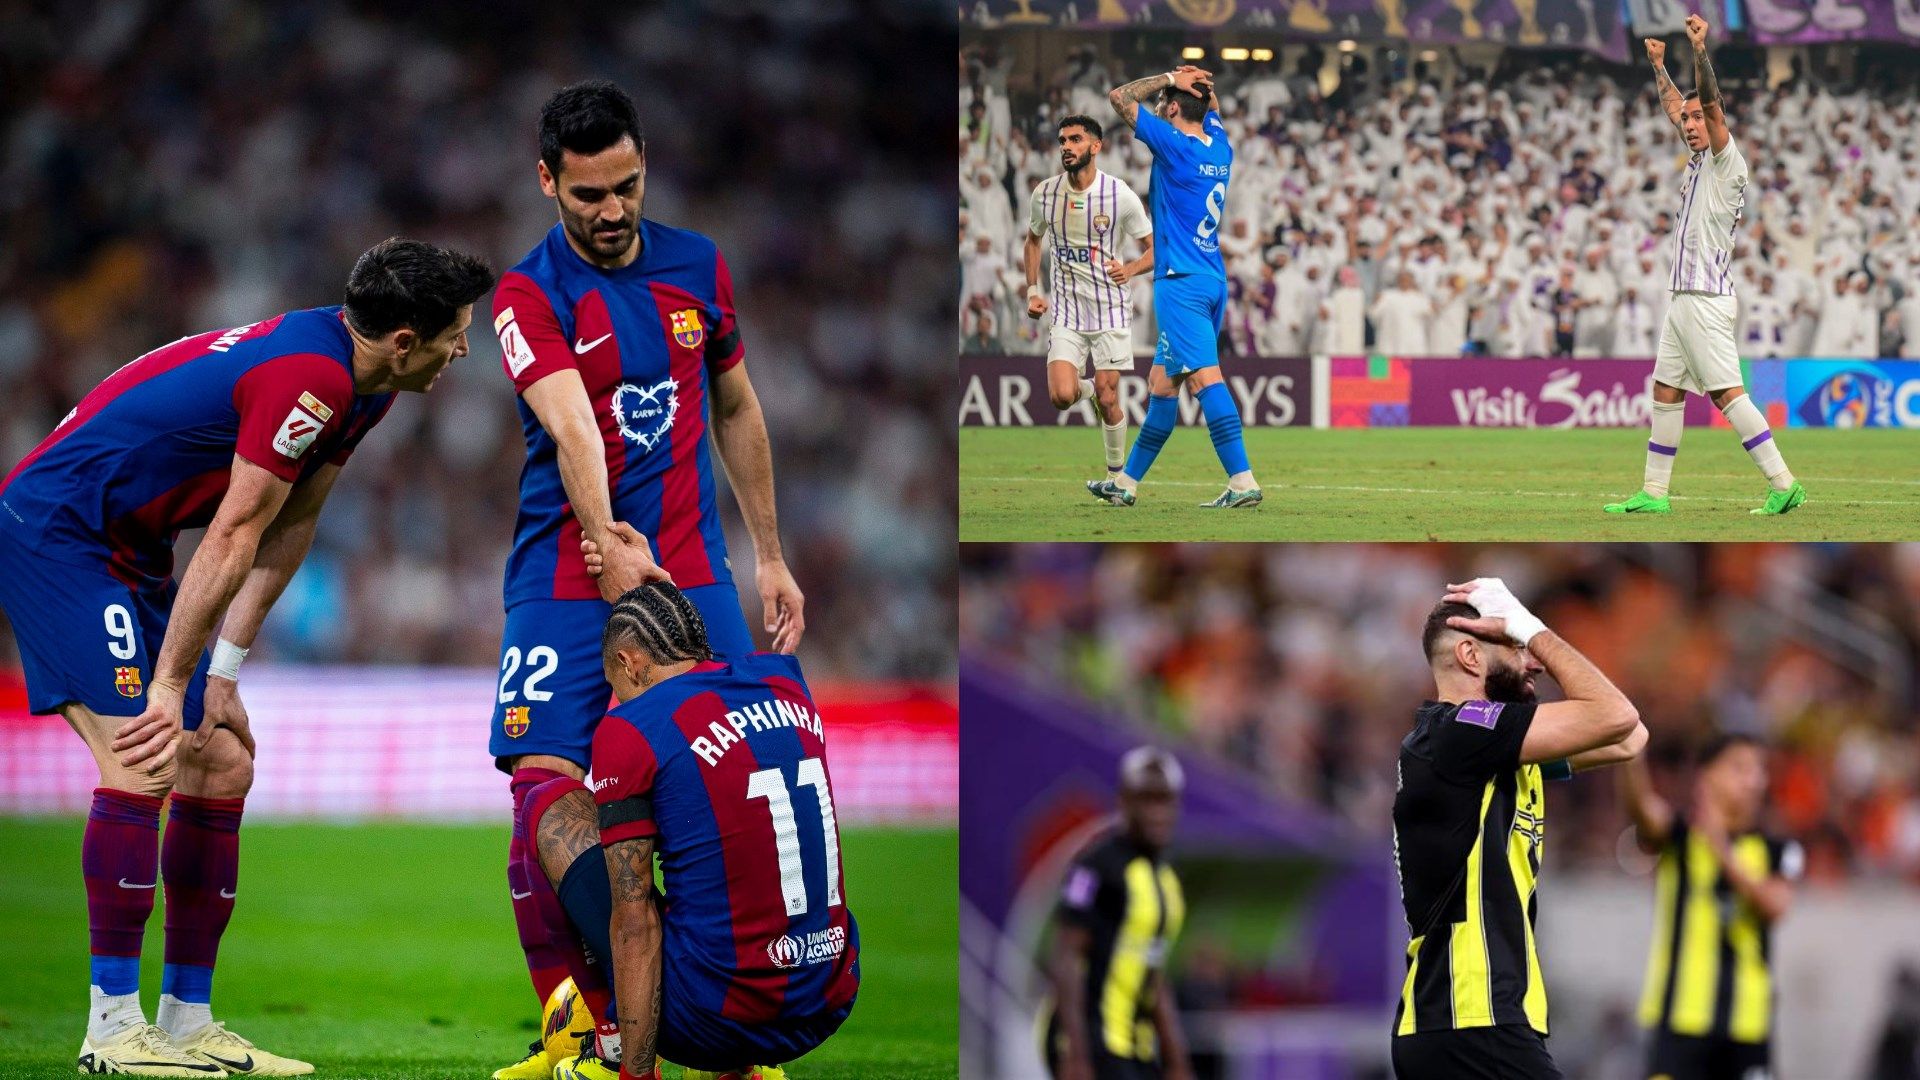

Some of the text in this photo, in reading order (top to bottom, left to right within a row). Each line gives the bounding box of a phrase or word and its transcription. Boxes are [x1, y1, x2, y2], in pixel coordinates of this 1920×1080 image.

[1451, 387, 1528, 427] Visit
[277, 437, 302, 454] LALIGA
[104, 604, 137, 660] 9
[498, 645, 559, 704] 22
[690, 699, 824, 768] RAPHINHA
[746, 757, 842, 917] 11
[806, 926, 845, 946] UNHCR
[806, 939, 845, 959] ACNUR
